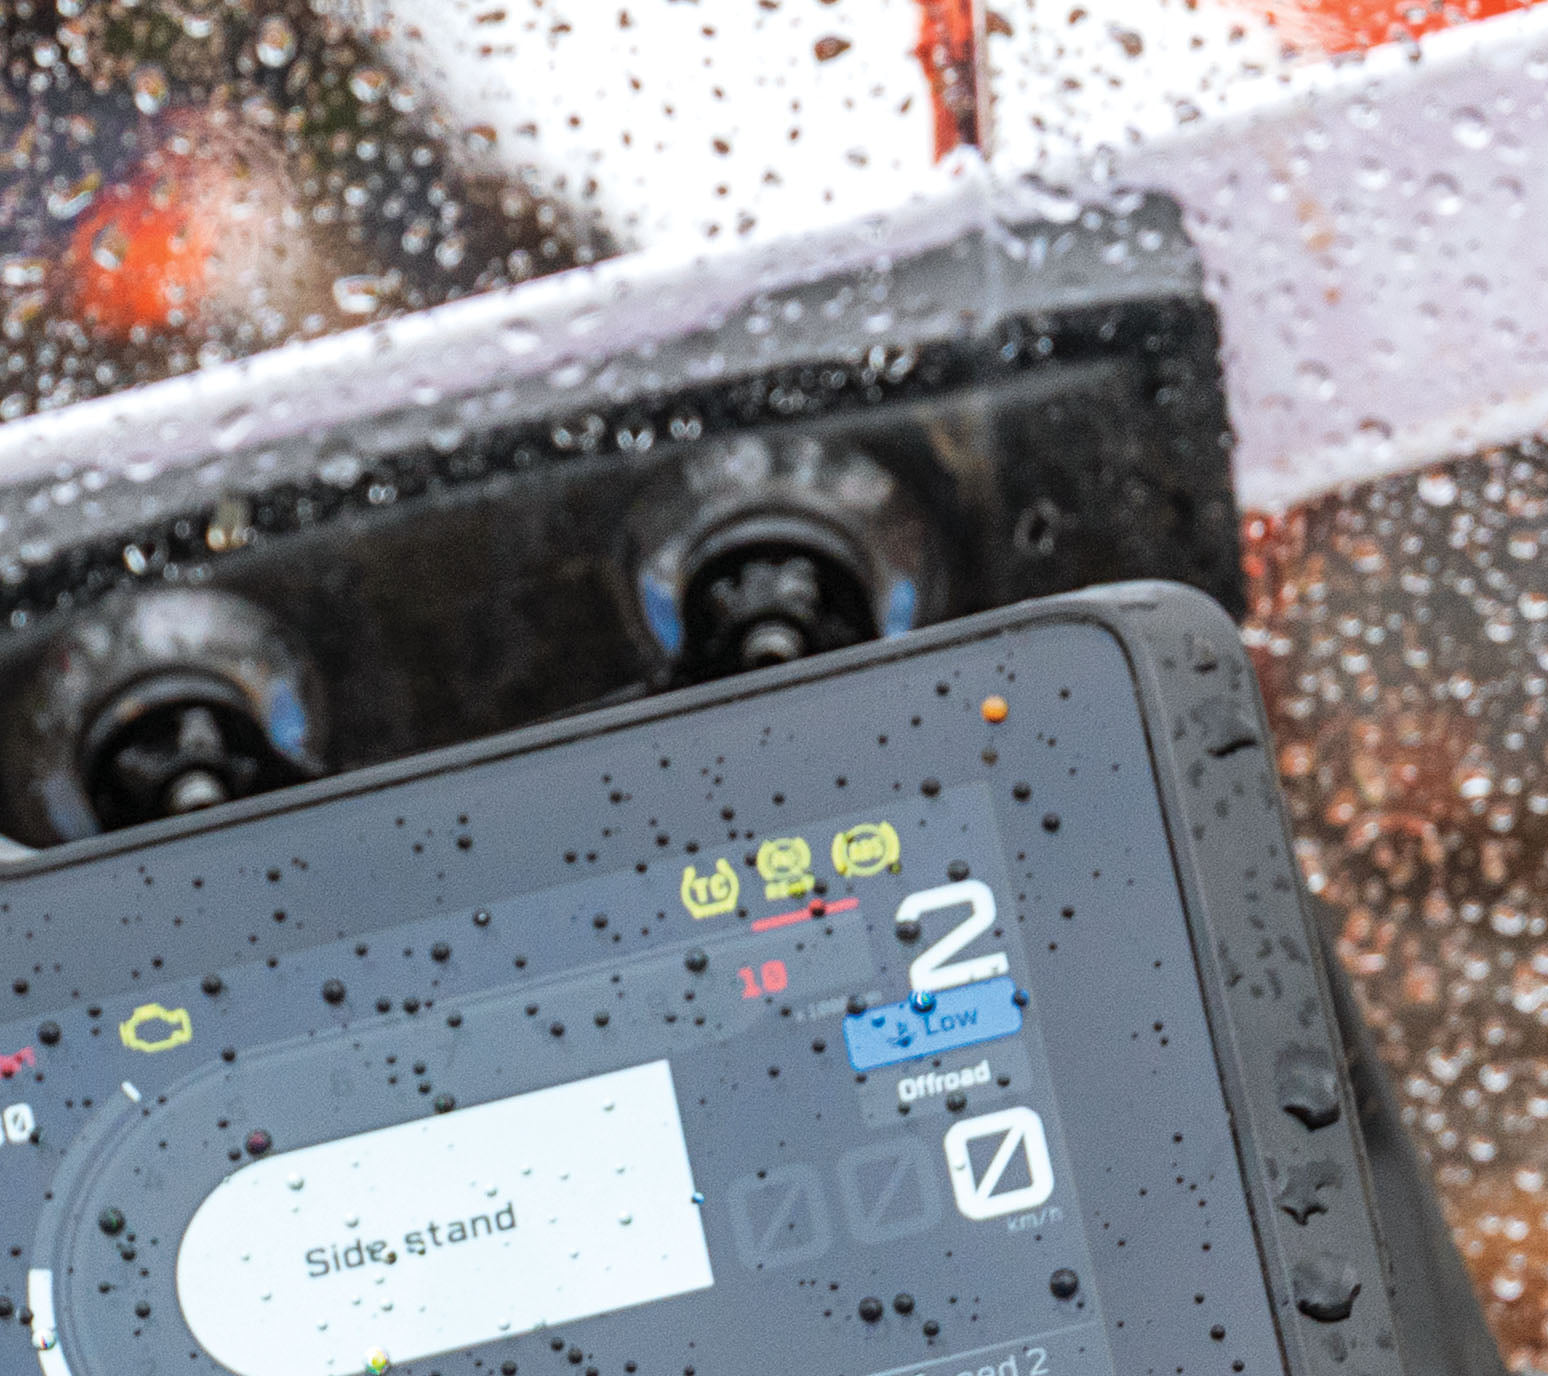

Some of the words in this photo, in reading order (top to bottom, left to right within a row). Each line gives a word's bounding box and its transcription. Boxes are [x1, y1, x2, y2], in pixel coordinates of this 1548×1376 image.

[896, 879, 1010, 991] 2
[924, 1008, 978, 1036] Low
[898, 1059, 991, 1102] Offroad
[305, 1237, 390, 1279] Side
[405, 1202, 519, 1253] stand
[1026, 1347, 1050, 1376] 2
